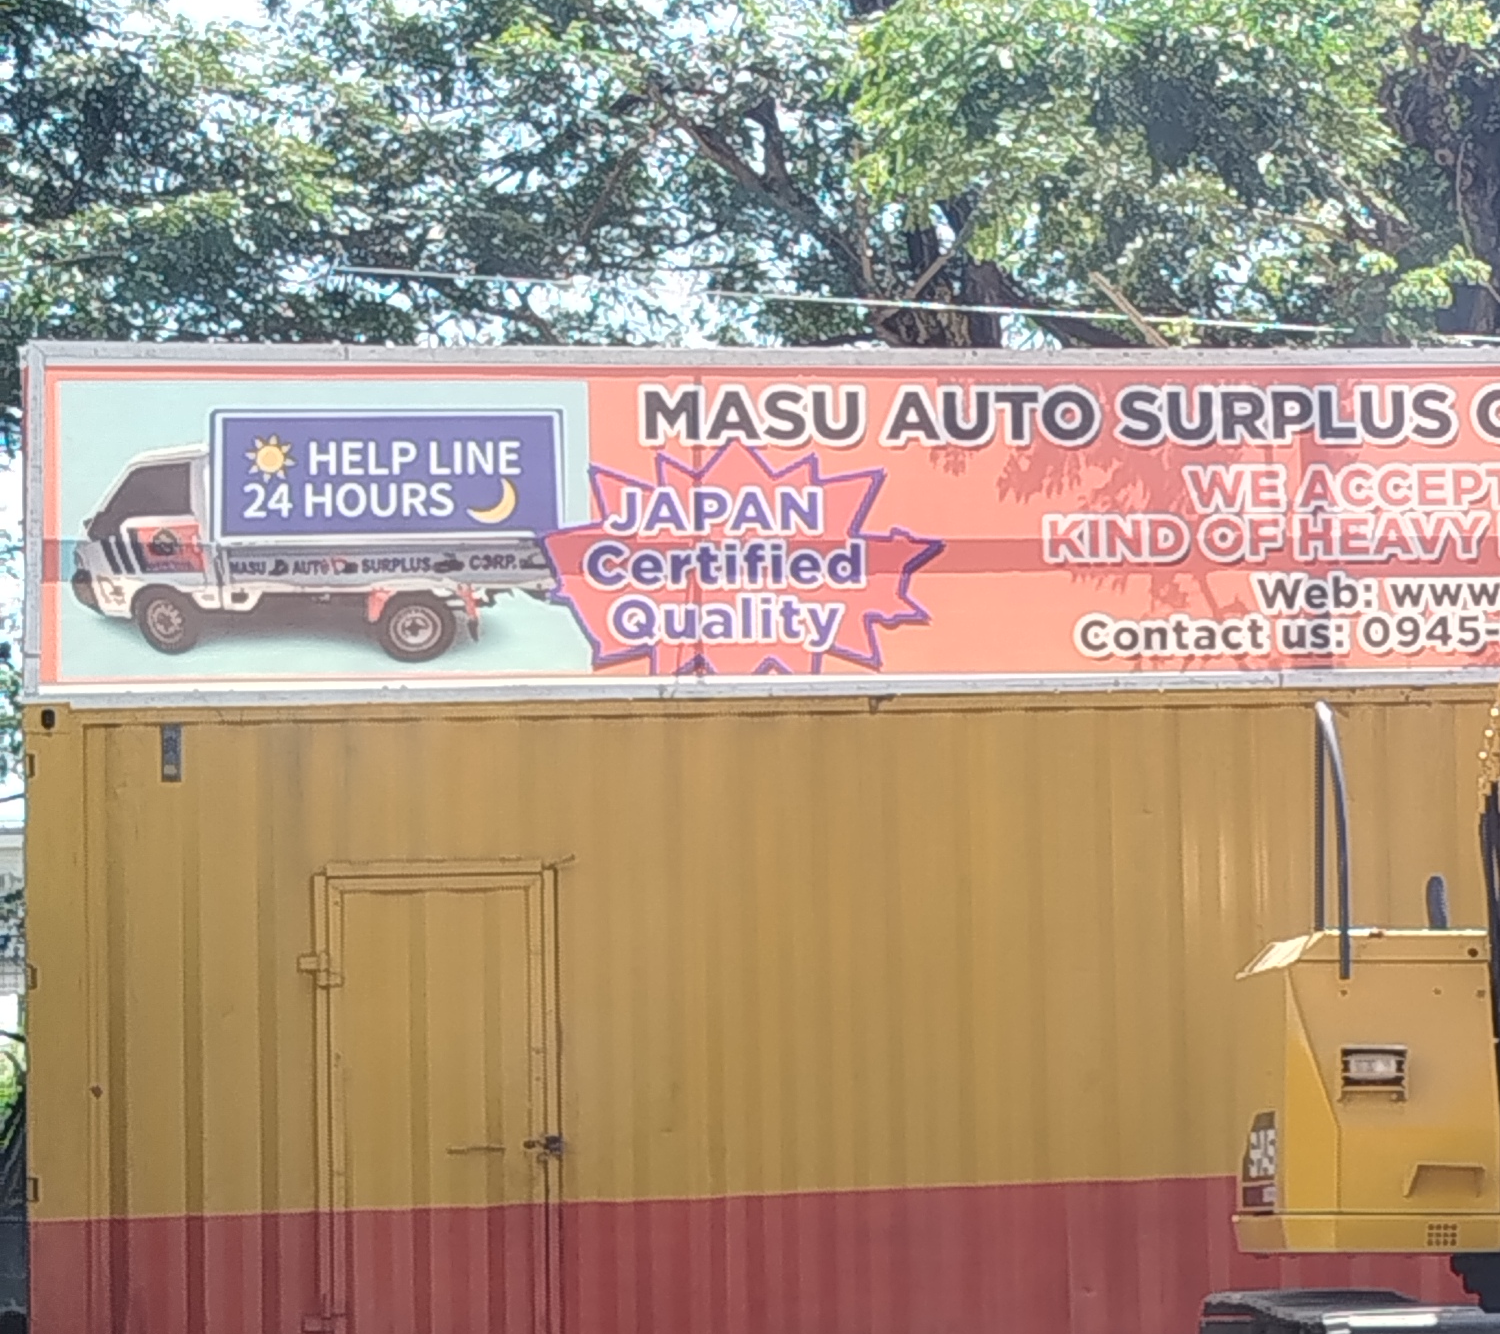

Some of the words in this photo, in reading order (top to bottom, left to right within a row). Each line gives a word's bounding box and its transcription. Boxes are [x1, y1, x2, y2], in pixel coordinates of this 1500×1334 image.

[643, 388, 861, 442] MASU
[887, 388, 1099, 443] AUTO
[1119, 388, 1452, 442] SURPLUS
[308, 439, 417, 476] HELP
[430, 439, 522, 476] LINE
[243, 483, 292, 519] 24
[304, 482, 455, 519] HOURS
[610, 489, 821, 532] JAPAN
[1188, 468, 1284, 512] WE
[1048, 518, 1187, 559] KIND
[1203, 516, 1281, 558] OF
[1308, 515, 1487, 558] HEAVY
[229, 560, 267, 575] MASU
[361, 557, 431, 574] SURPLUS
[587, 541, 864, 587] Certified
[1258, 576, 1375, 611] Web:
[611, 596, 843, 649] Quality
[1079, 617, 1266, 654] Contact
[1281, 621, 1350, 652] us:
